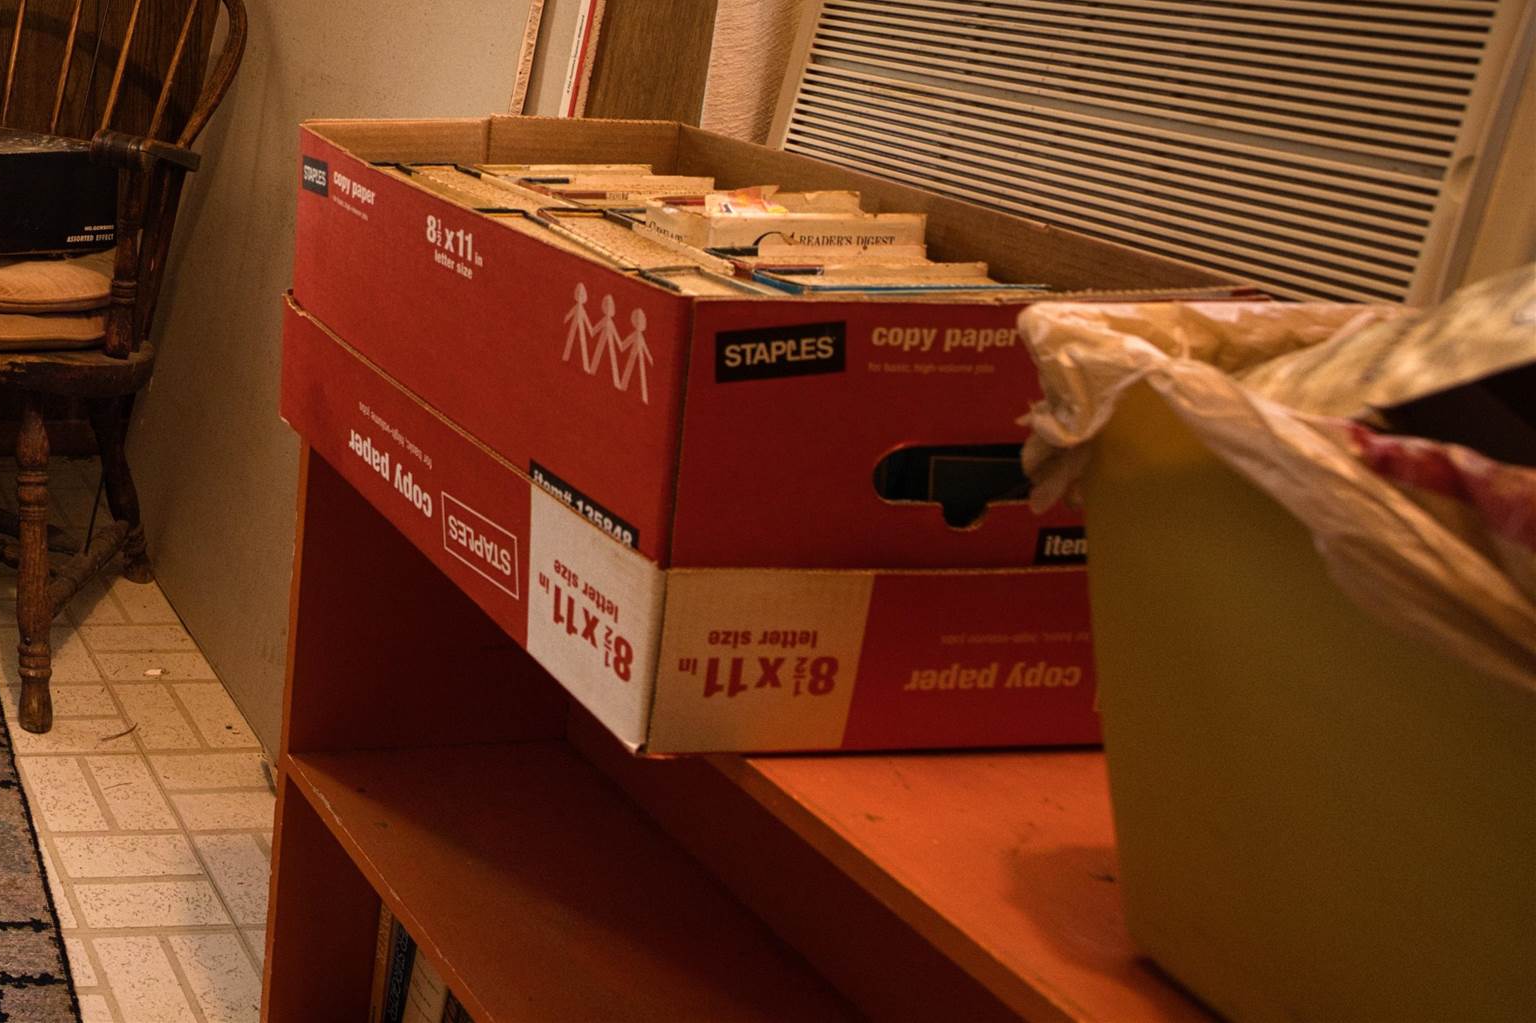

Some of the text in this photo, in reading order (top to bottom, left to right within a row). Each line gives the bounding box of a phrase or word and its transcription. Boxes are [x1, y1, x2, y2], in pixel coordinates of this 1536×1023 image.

[303, 164, 327, 187] STAPLES
[333, 171, 376, 206] copy paper
[799, 234, 895, 248] READER'S DIGEST
[435, 249, 473, 279] letter size
[475, 252, 483, 267] in
[724, 337, 835, 367] STAPLES
[871, 325, 1017, 352] copy paper
[349, 429, 433, 518] copy paper
[448, 515, 512, 576] STAPLES
[539, 572, 550, 594] in
[553, 559, 619, 623] letter size
[708, 629, 817, 648] letter size
[678, 658, 697, 675] in
[904, 662, 1081, 692] copy paper
